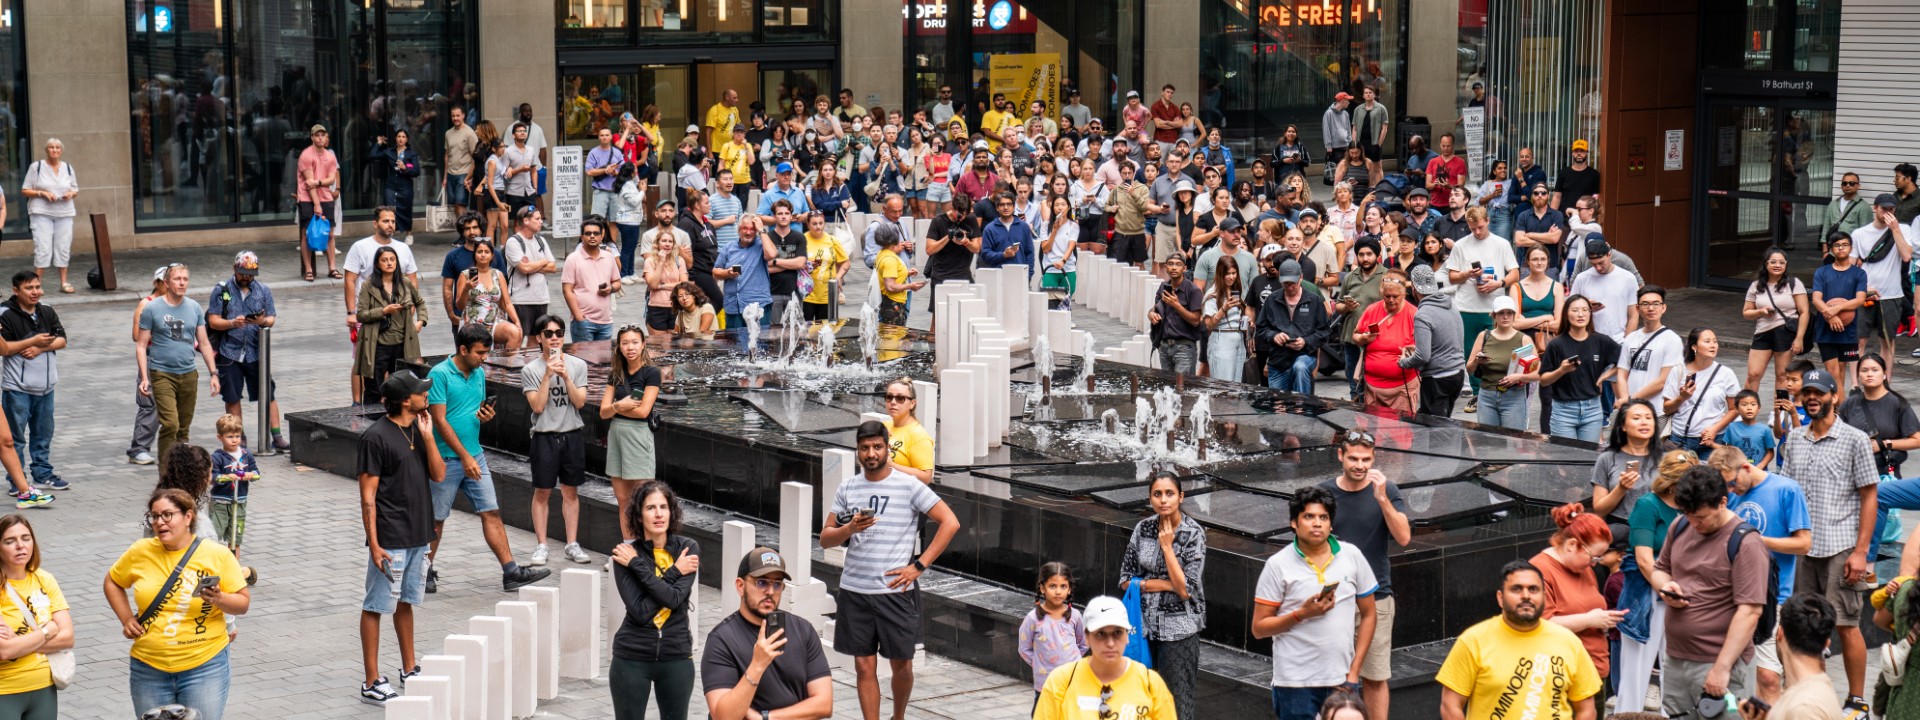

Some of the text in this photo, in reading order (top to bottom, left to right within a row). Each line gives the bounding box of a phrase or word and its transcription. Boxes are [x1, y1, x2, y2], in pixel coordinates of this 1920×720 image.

[924, 19, 985, 28] DRU RT
[1036, 64, 1048, 100] MINOES
[1762, 80, 1813, 90] 19 Bathurst St
[1016, 67, 1041, 119] DOMINOES
[1048, 63, 1056, 117] DOMINOES
[563, 156, 572, 164] NO
[557, 165, 578, 173] PARKING
[552, 397, 567, 407] YA
[869, 495, 890, 514] 07
[1551, 656, 1564, 720] MINOES
